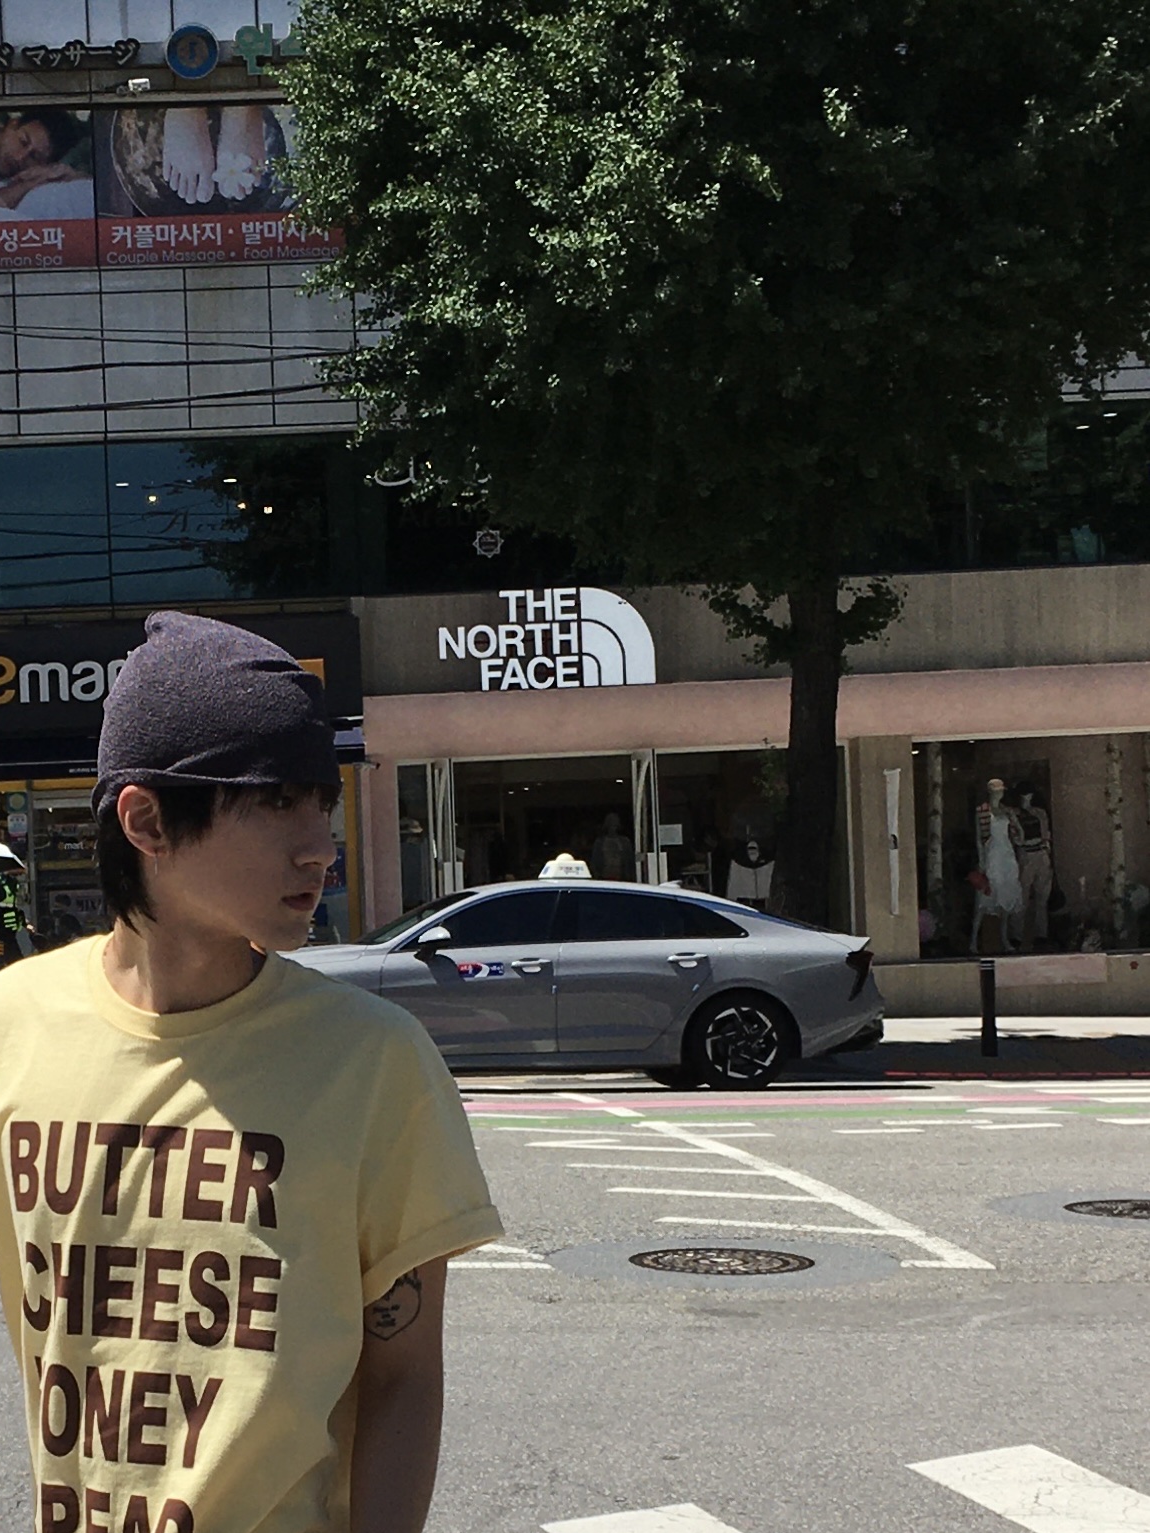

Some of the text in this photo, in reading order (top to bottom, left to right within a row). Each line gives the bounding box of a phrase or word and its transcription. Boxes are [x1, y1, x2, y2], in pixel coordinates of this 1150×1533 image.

[25, 42, 137, 67] マッサージ
[110, 222, 223, 249] 커플마사지
[34, 252, 64, 267] Spa
[106, 250, 159, 266] Couple
[162, 248, 226, 264] Massage
[276, 245, 340, 258] Massage
[498, 587, 578, 623] THE
[438, 621, 579, 661] NORTH
[480, 654, 581, 692] FACE
[9, 1120, 285, 1229] BUTTER
[22, 1241, 282, 1352] CHEESE
[34, 1355, 224, 1469] ONEY
